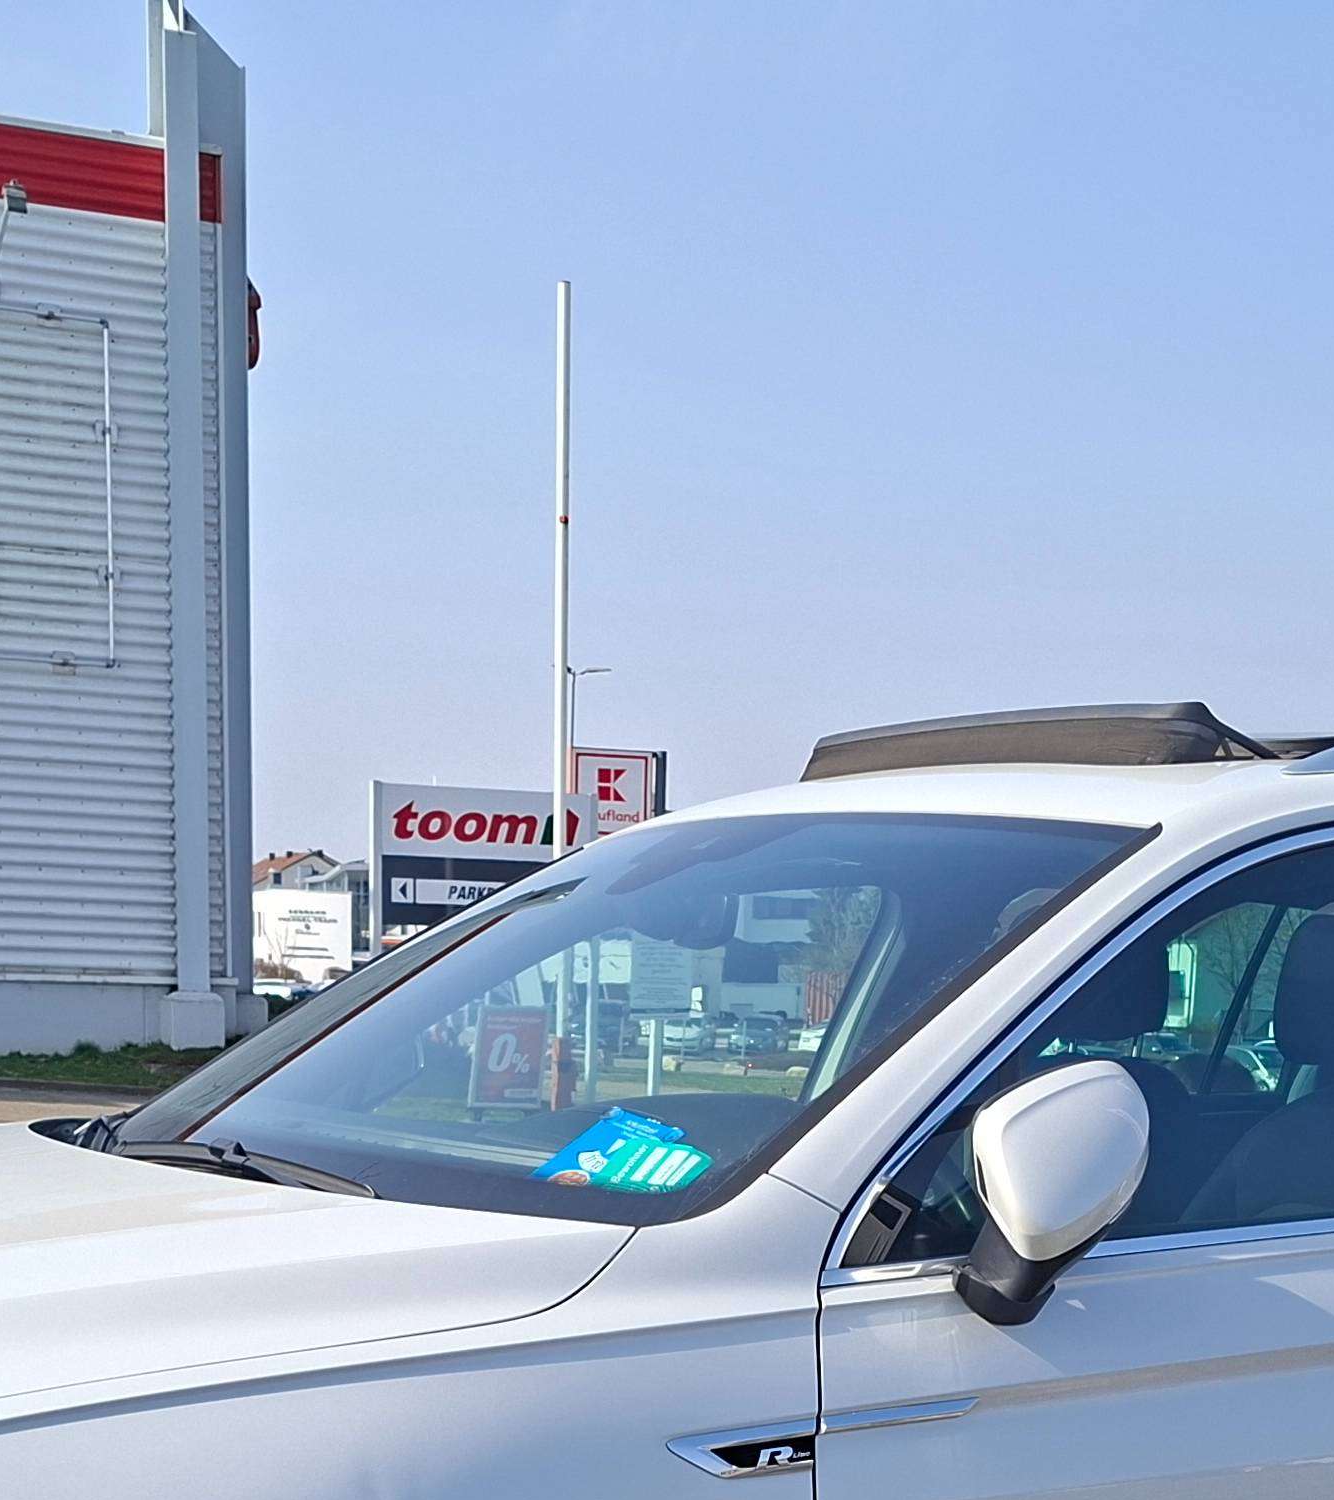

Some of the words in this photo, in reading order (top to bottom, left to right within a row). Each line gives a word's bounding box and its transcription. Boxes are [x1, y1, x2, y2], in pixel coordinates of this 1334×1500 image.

[598, 767, 627, 802] K
[393, 800, 538, 845] toom
[598, 809, 640, 823] ufland
